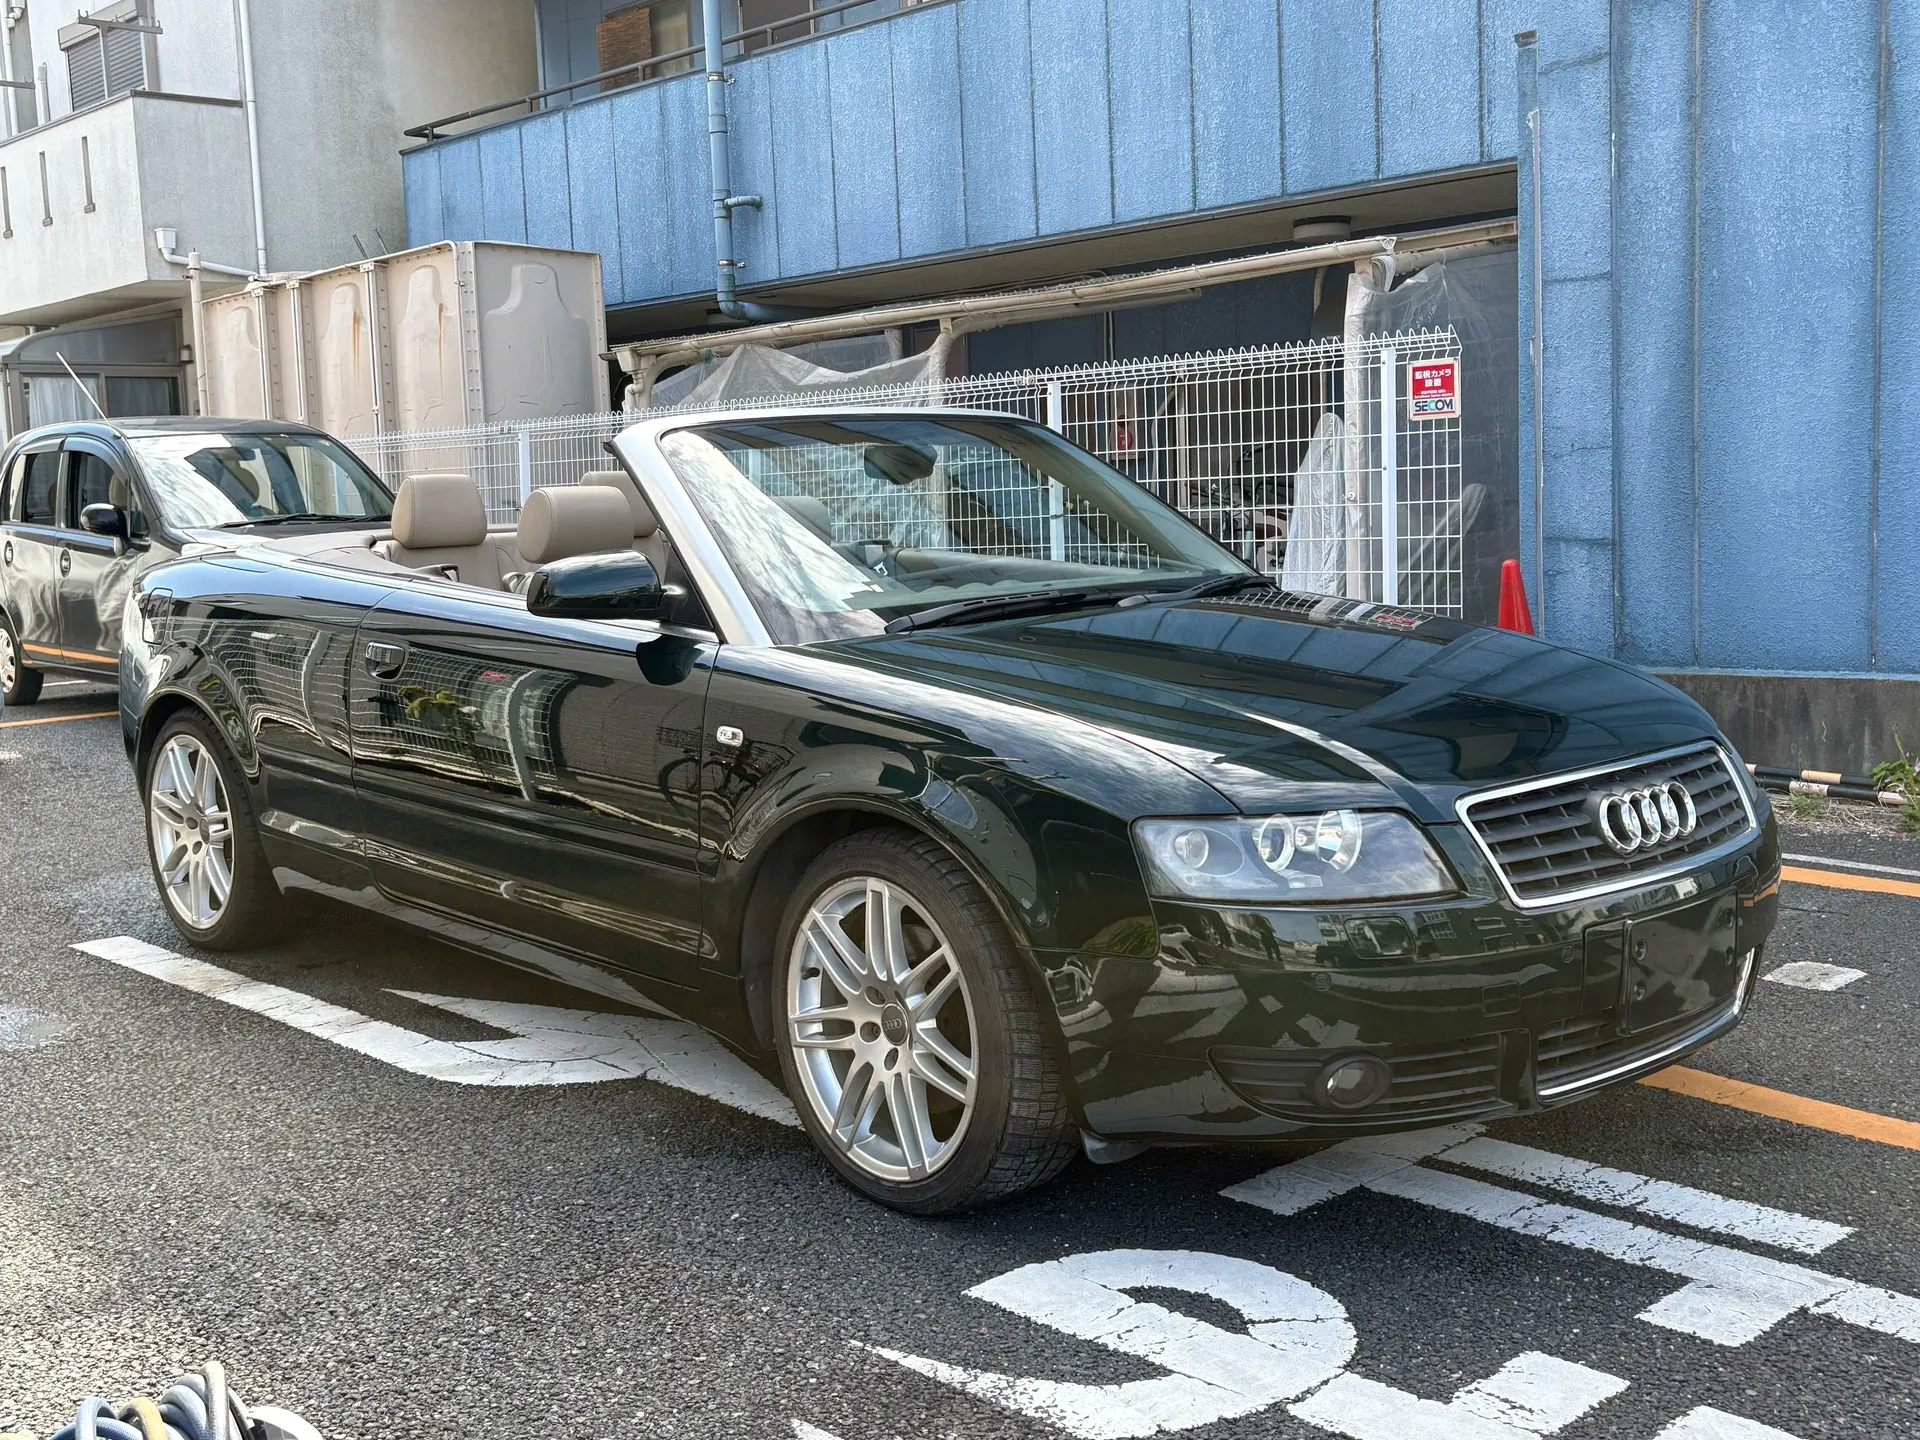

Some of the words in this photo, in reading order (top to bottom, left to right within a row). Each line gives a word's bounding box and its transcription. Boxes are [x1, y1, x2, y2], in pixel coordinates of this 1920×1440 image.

[1415, 368, 1452, 380] 監視カメラ
[1425, 378, 1442, 388] 設置
[1415, 399, 1453, 412] SECOM
